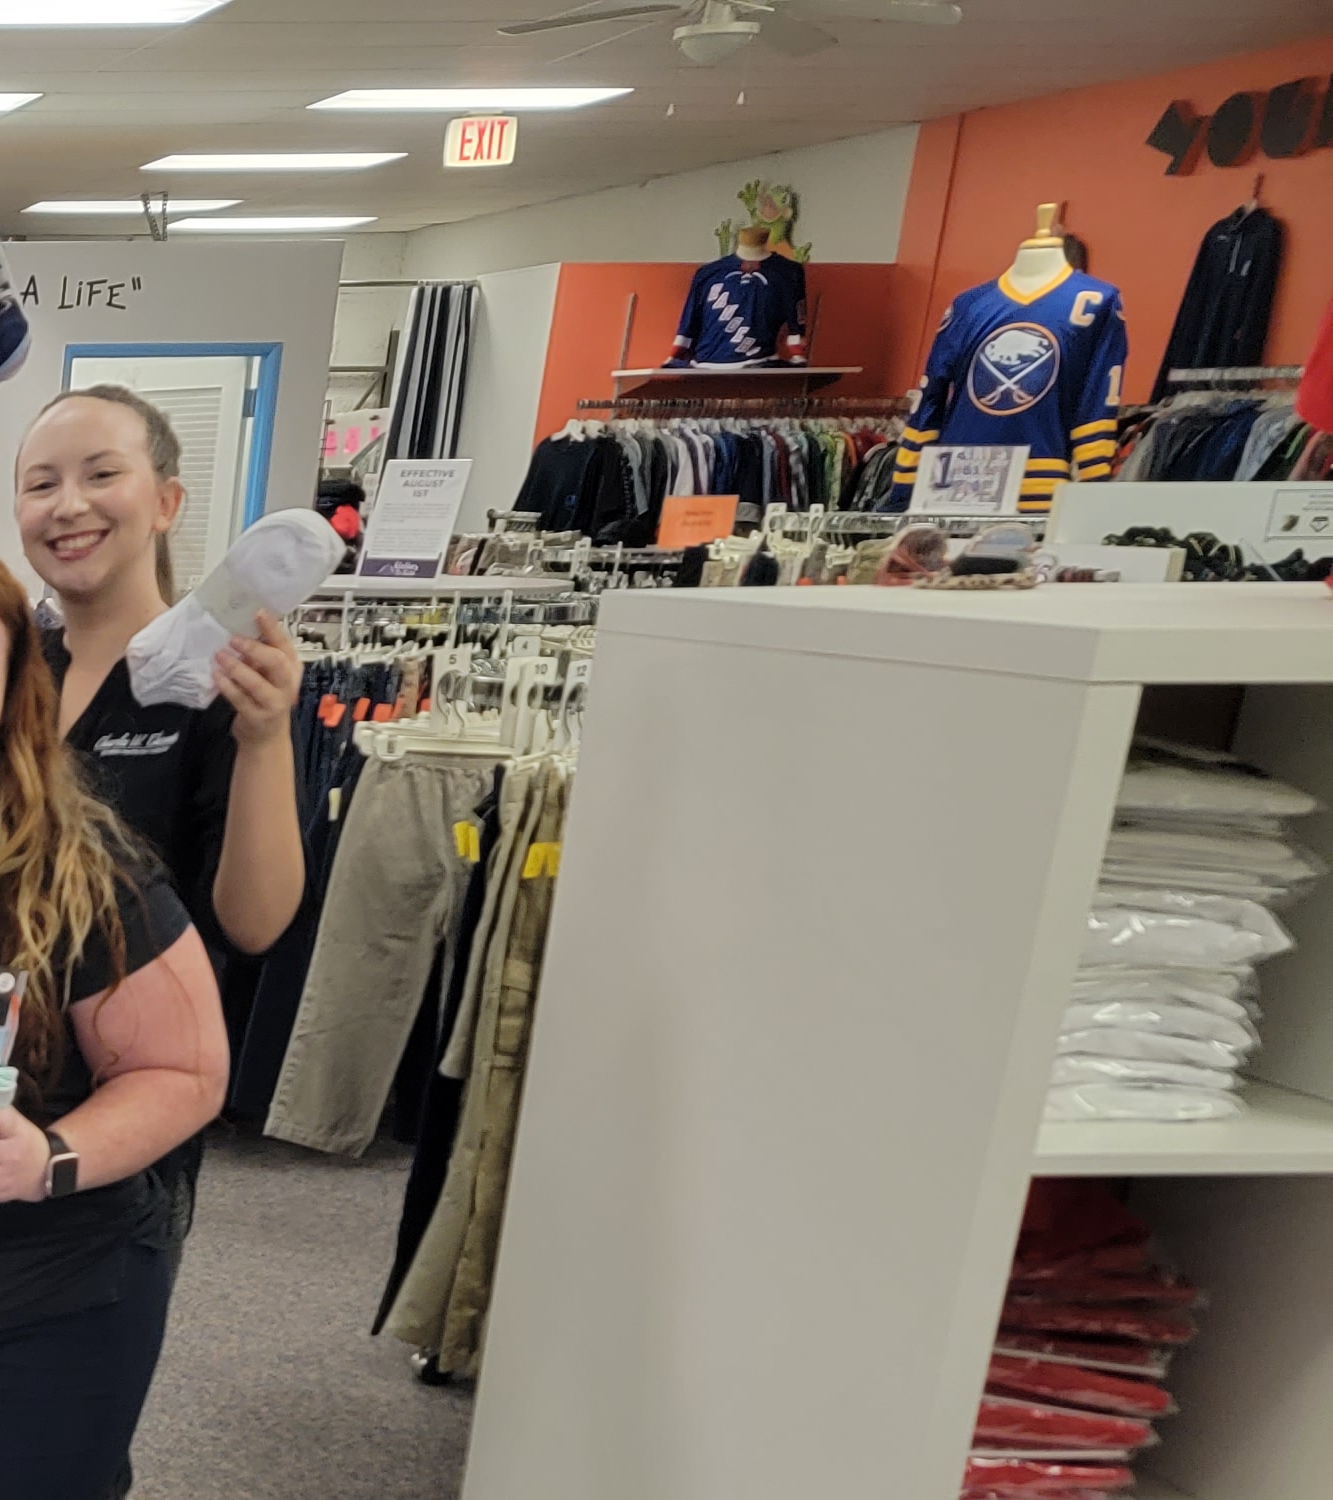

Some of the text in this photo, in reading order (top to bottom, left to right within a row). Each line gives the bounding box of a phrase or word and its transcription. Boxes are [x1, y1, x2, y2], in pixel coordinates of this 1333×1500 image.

[459, 119, 510, 162] EXIT
[20, 274, 40, 307] A
[1069, 290, 1105, 328] C
[399, 469, 456, 478] EFFECTIVE
[402, 479, 445, 488] AUGUST
[448, 653, 458, 666] 5
[534, 663, 549, 676] 10
